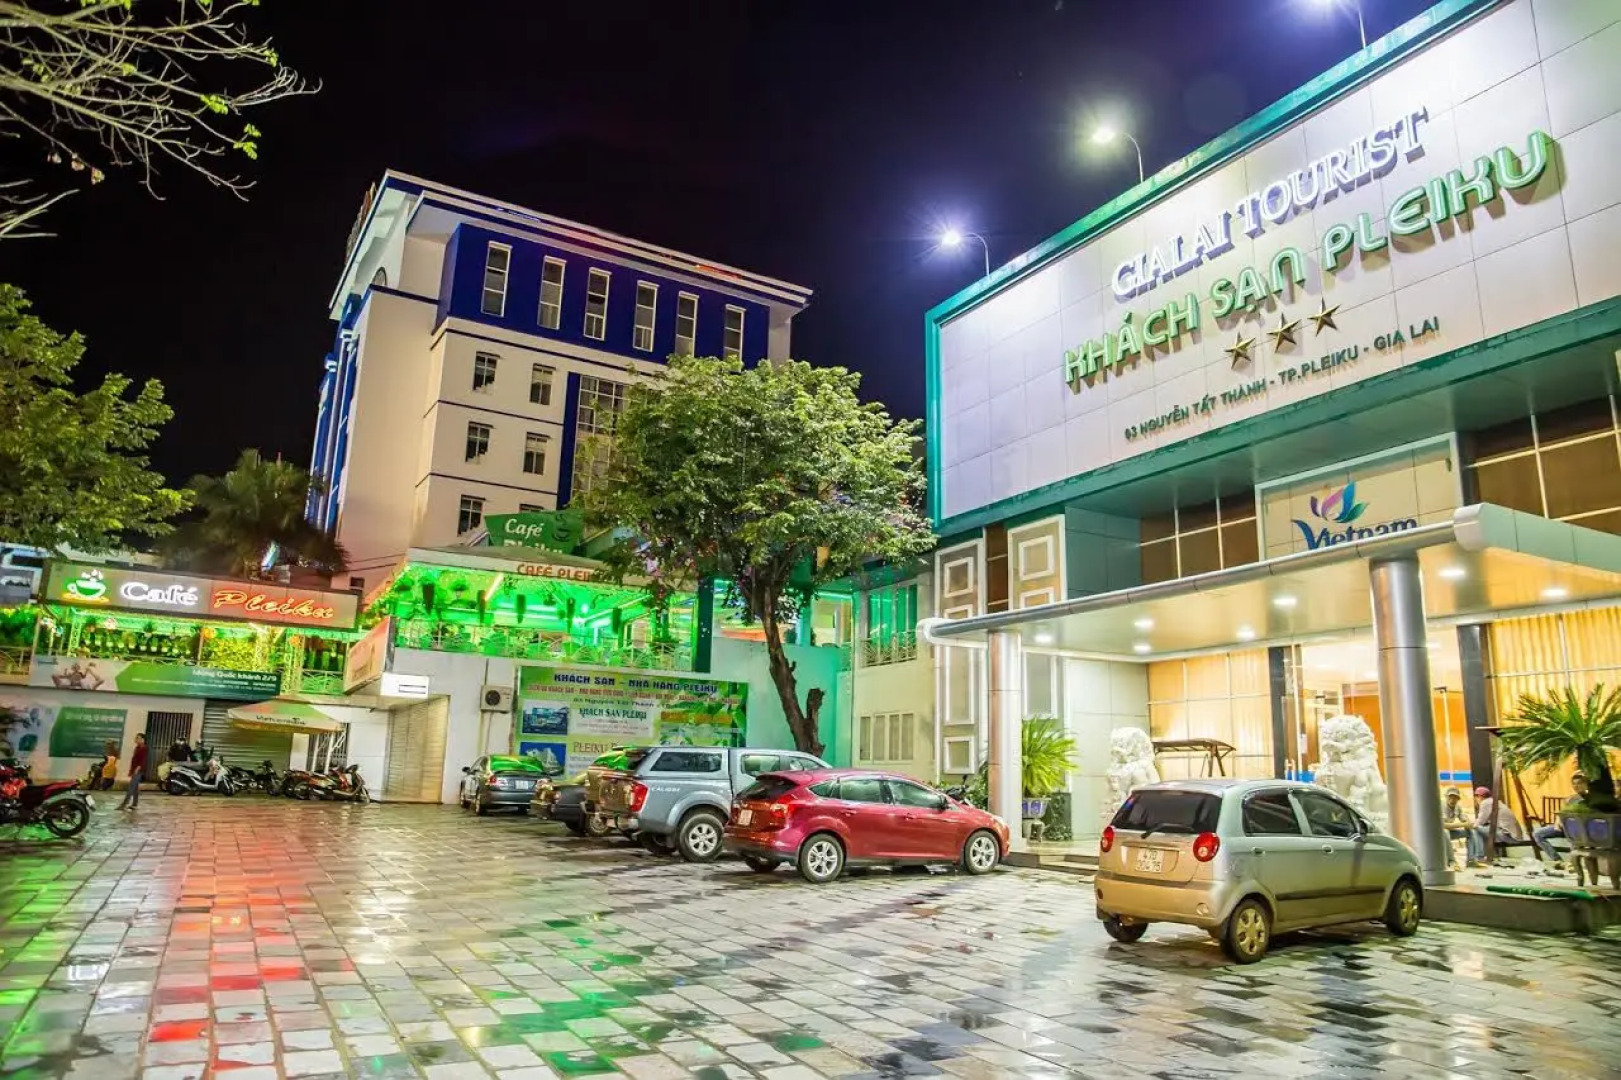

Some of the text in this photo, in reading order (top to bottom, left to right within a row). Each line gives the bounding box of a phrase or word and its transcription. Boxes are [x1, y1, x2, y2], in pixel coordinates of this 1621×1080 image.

[1236, 106, 1430, 239] TOURIST
[1064, 130, 1550, 384] KHÁCH SẠN PLEIKU
[1140, 405, 1190, 434] NGUYỄN
[1193, 392, 1217, 415] TẤT
[1220, 378, 1267, 405] THÀNH
[1278, 345, 1358, 385] TP.PLEIKU
[1373, 330, 1406, 351] GIA
[1409, 316, 1440, 339] LAI
[505, 518, 544, 539] Café
[120, 581, 336, 620] Café Pleiku
[517, 563, 553, 578] CAFÉ
